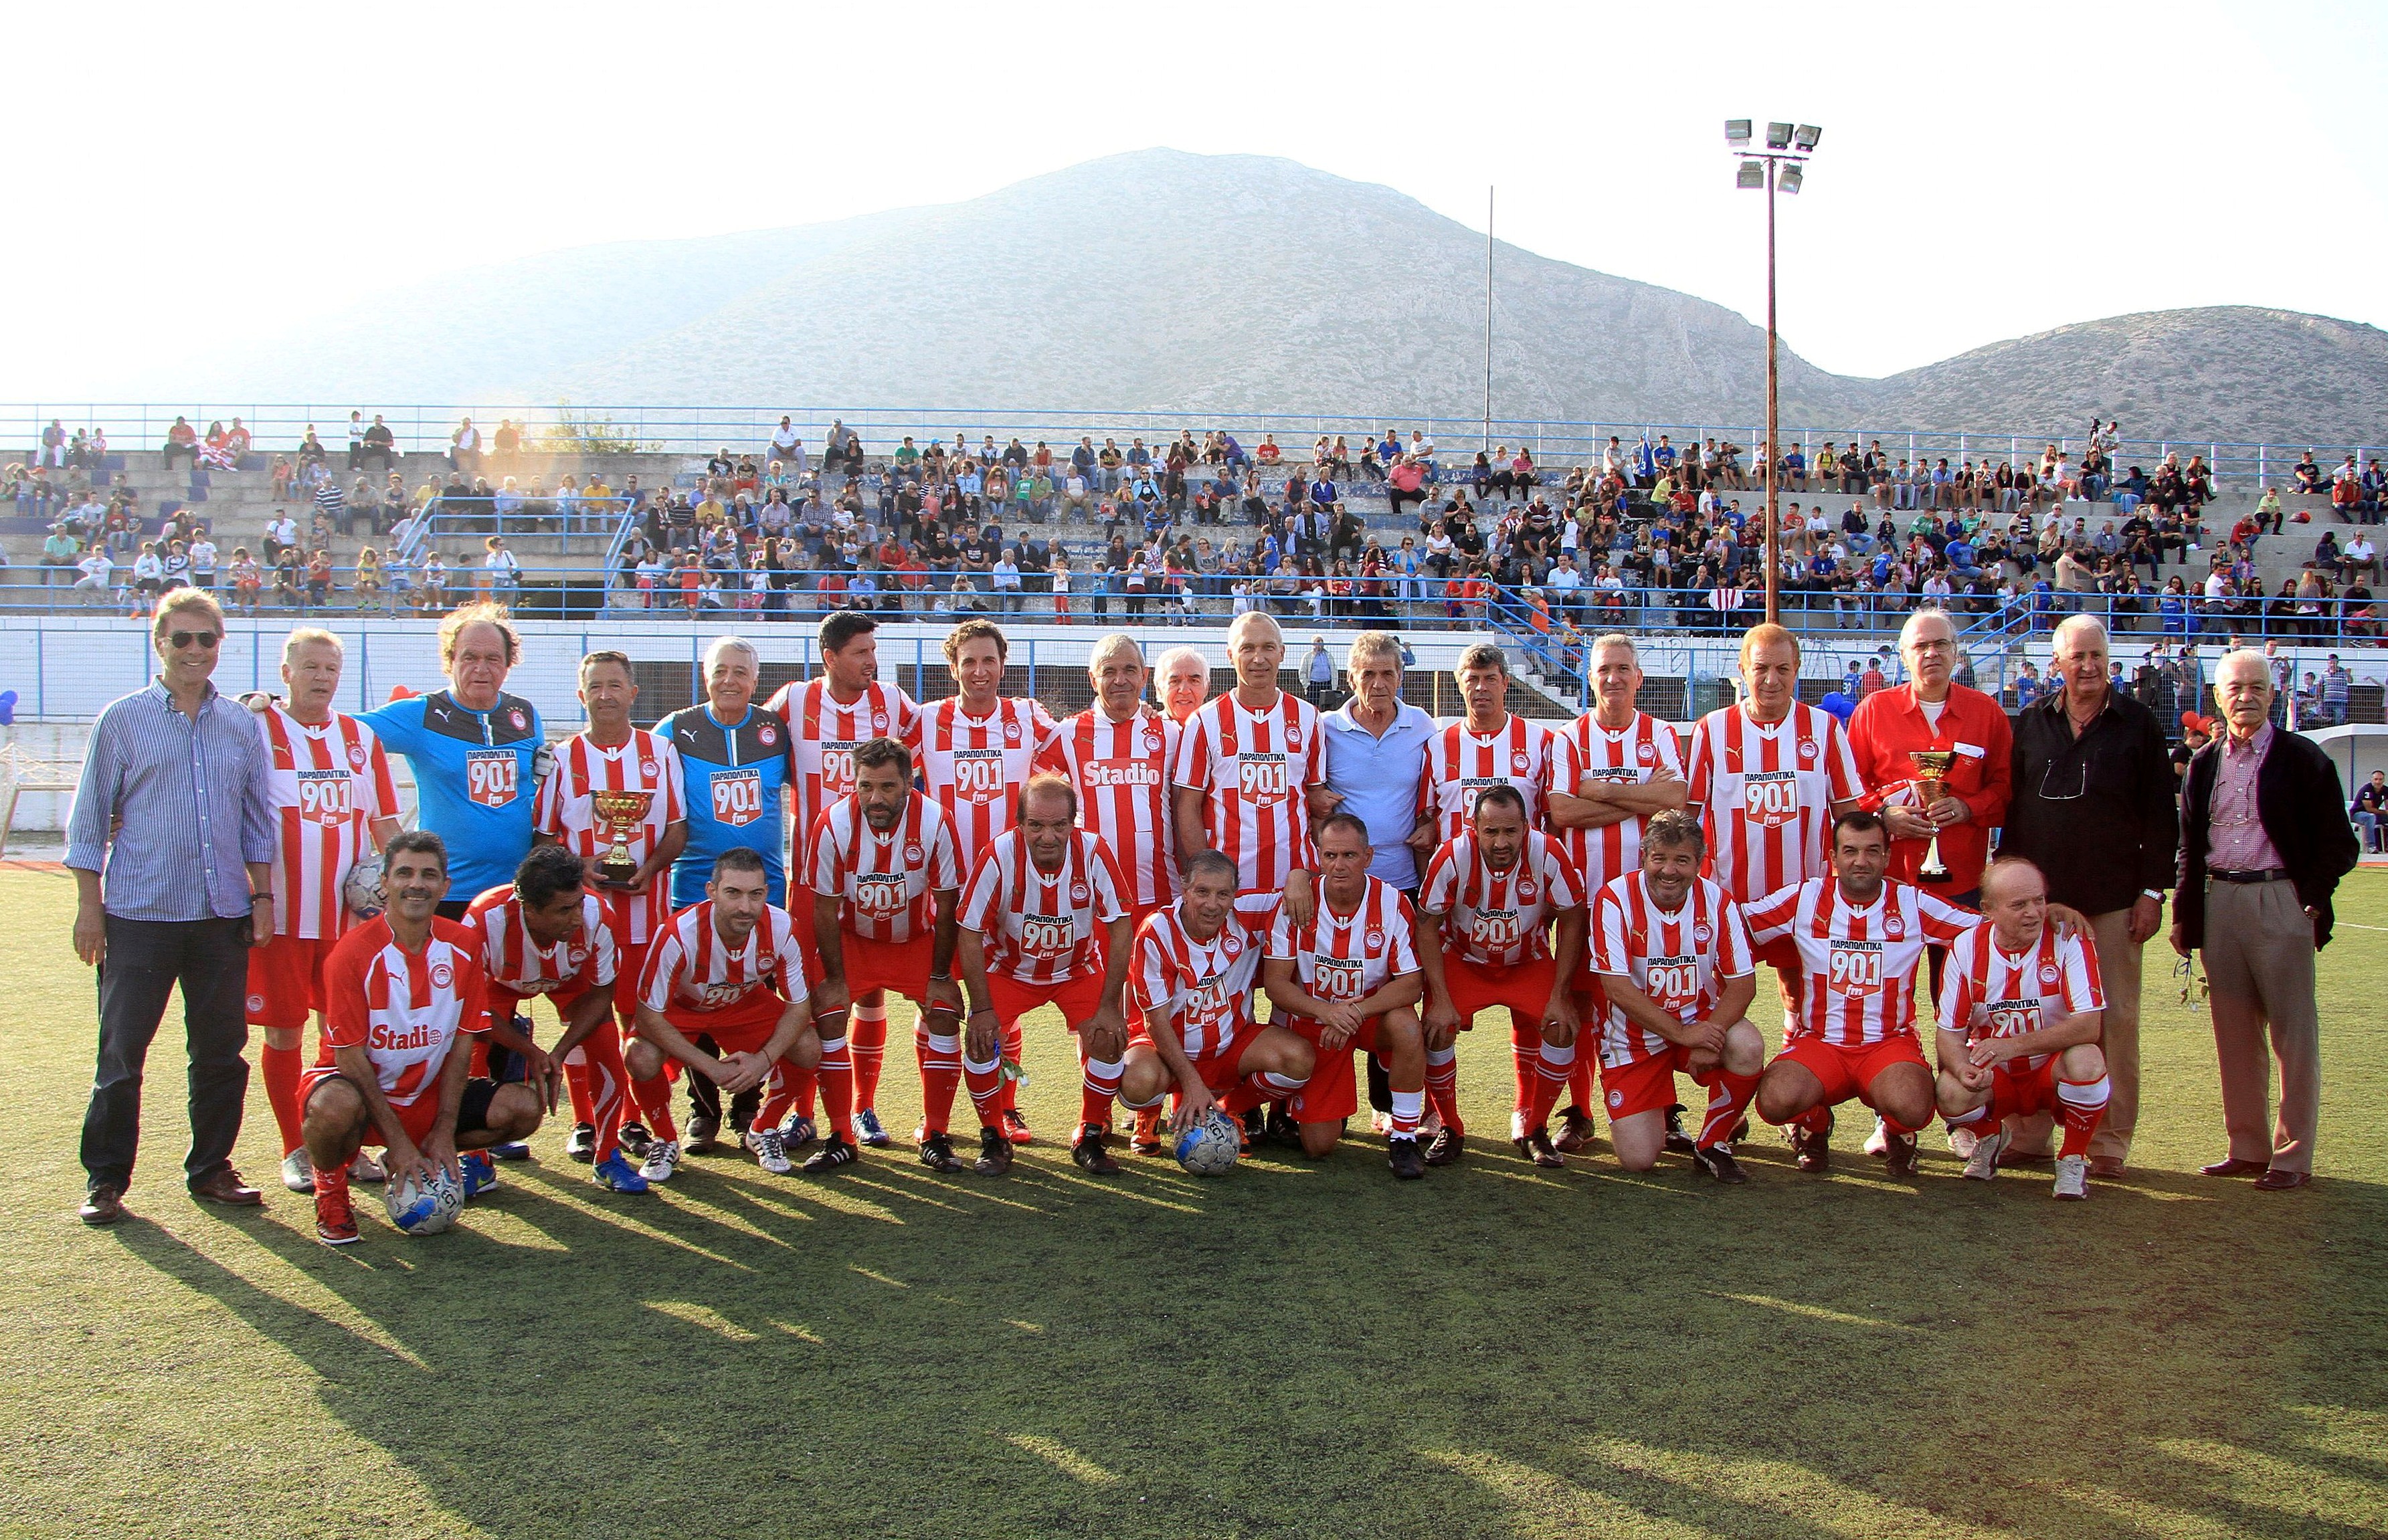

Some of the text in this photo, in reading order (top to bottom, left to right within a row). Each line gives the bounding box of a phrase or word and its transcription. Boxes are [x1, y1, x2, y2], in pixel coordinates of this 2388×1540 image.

[468, 751, 515, 760] ΠΑΡΑΠΟΛΙΤΙΚΑ
[954, 750, 1002, 759] ΠΑΡΑΠΟΛΙΤΙΚΑ
[1239, 753, 1285, 761] ΠΑΡΑΠΟΛΙΤΙΚΑ
[298, 771, 351, 779] ΠΑΡΑΠΟΛΙΤΙΚΑ
[711, 769, 759, 781] ΠΑΡΑΠΟΛΙΤΙΚΑ
[1084, 761, 1160, 787] Stadio
[1745, 771, 1796, 781] ΠΑΡΑΠΟΛΙΤΙΚΑ
[838, 782, 854, 795] fm
[487, 793, 503, 806] fm
[972, 791, 988, 803] fm
[1256, 794, 1271, 805] fm
[320, 813, 337, 825] fm
[731, 813, 748, 825] fm
[1764, 813, 1780, 826] fm
[857, 872, 905, 883] ΠΑΡΑΠΟΛΙΤΙΚΑ
[1024, 913, 1073, 924] ΠΑΡΑΠΟΛΙΤΙΚΑ
[1831, 940, 1882, 951] ΠΑΡΑΠΟΛΙΤΙΚΑ
[1038, 949, 1054, 958] fm
[1315, 955, 1363, 968] ΠΑΡΑΠΟΛΙΤΙΚΑ
[1846, 984, 1863, 996] fm
[1663, 998, 1679, 1009] fm
[1200, 1012, 1215, 1025] fm
